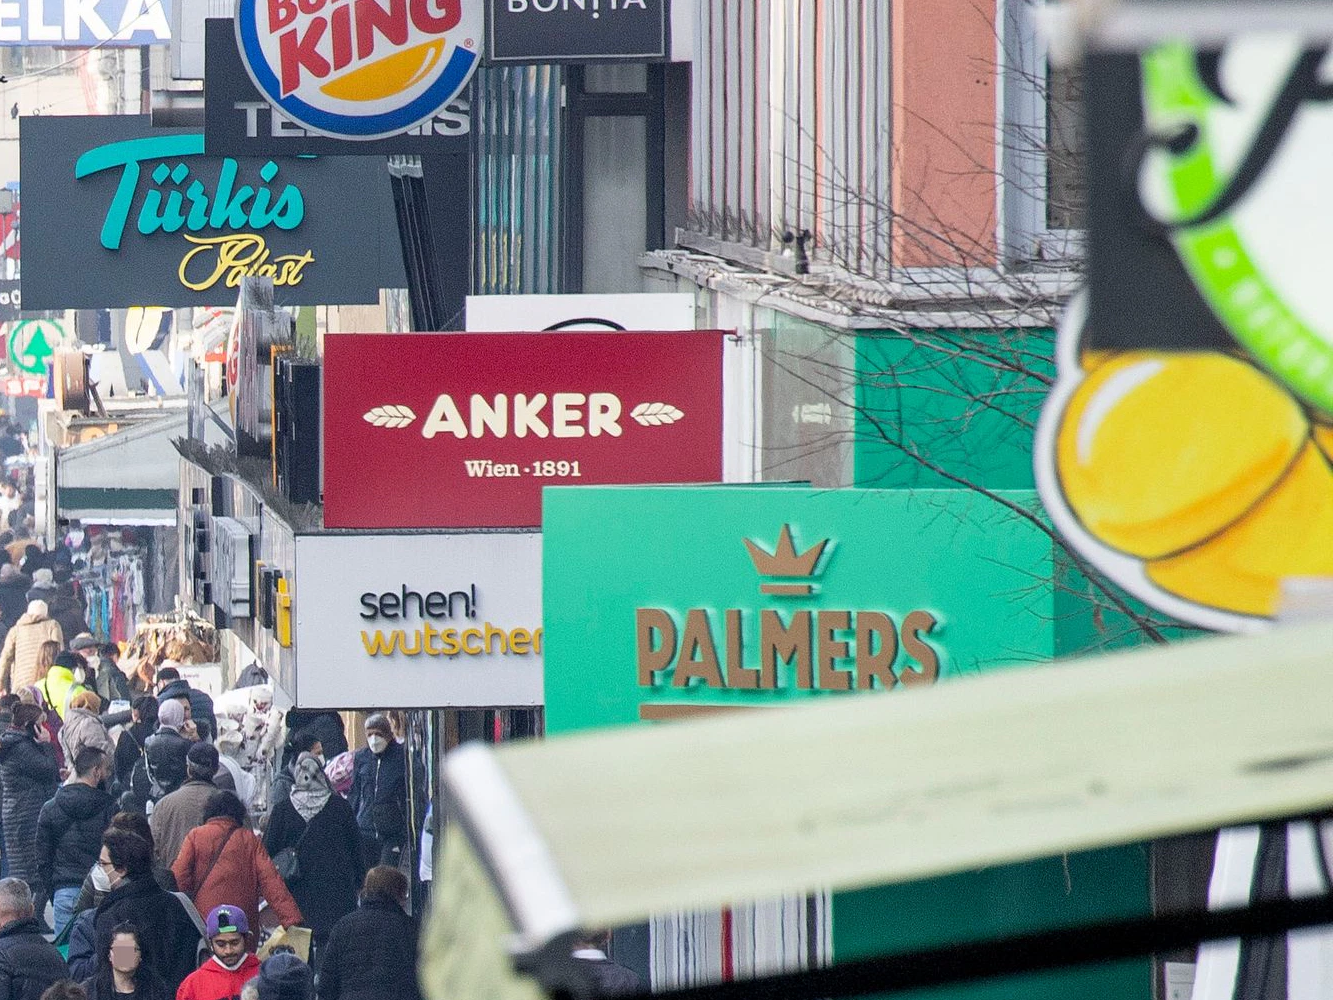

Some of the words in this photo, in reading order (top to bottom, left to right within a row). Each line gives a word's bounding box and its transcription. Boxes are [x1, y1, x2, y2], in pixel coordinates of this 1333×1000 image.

[280, 0, 461, 96] KING
[75, 133, 304, 250] Türkis
[422, 392, 623, 439] ANKER
[465, 460, 520, 478] Wien
[360, 583, 477, 619] sehen!
[636, 607, 943, 691] PALMERS
